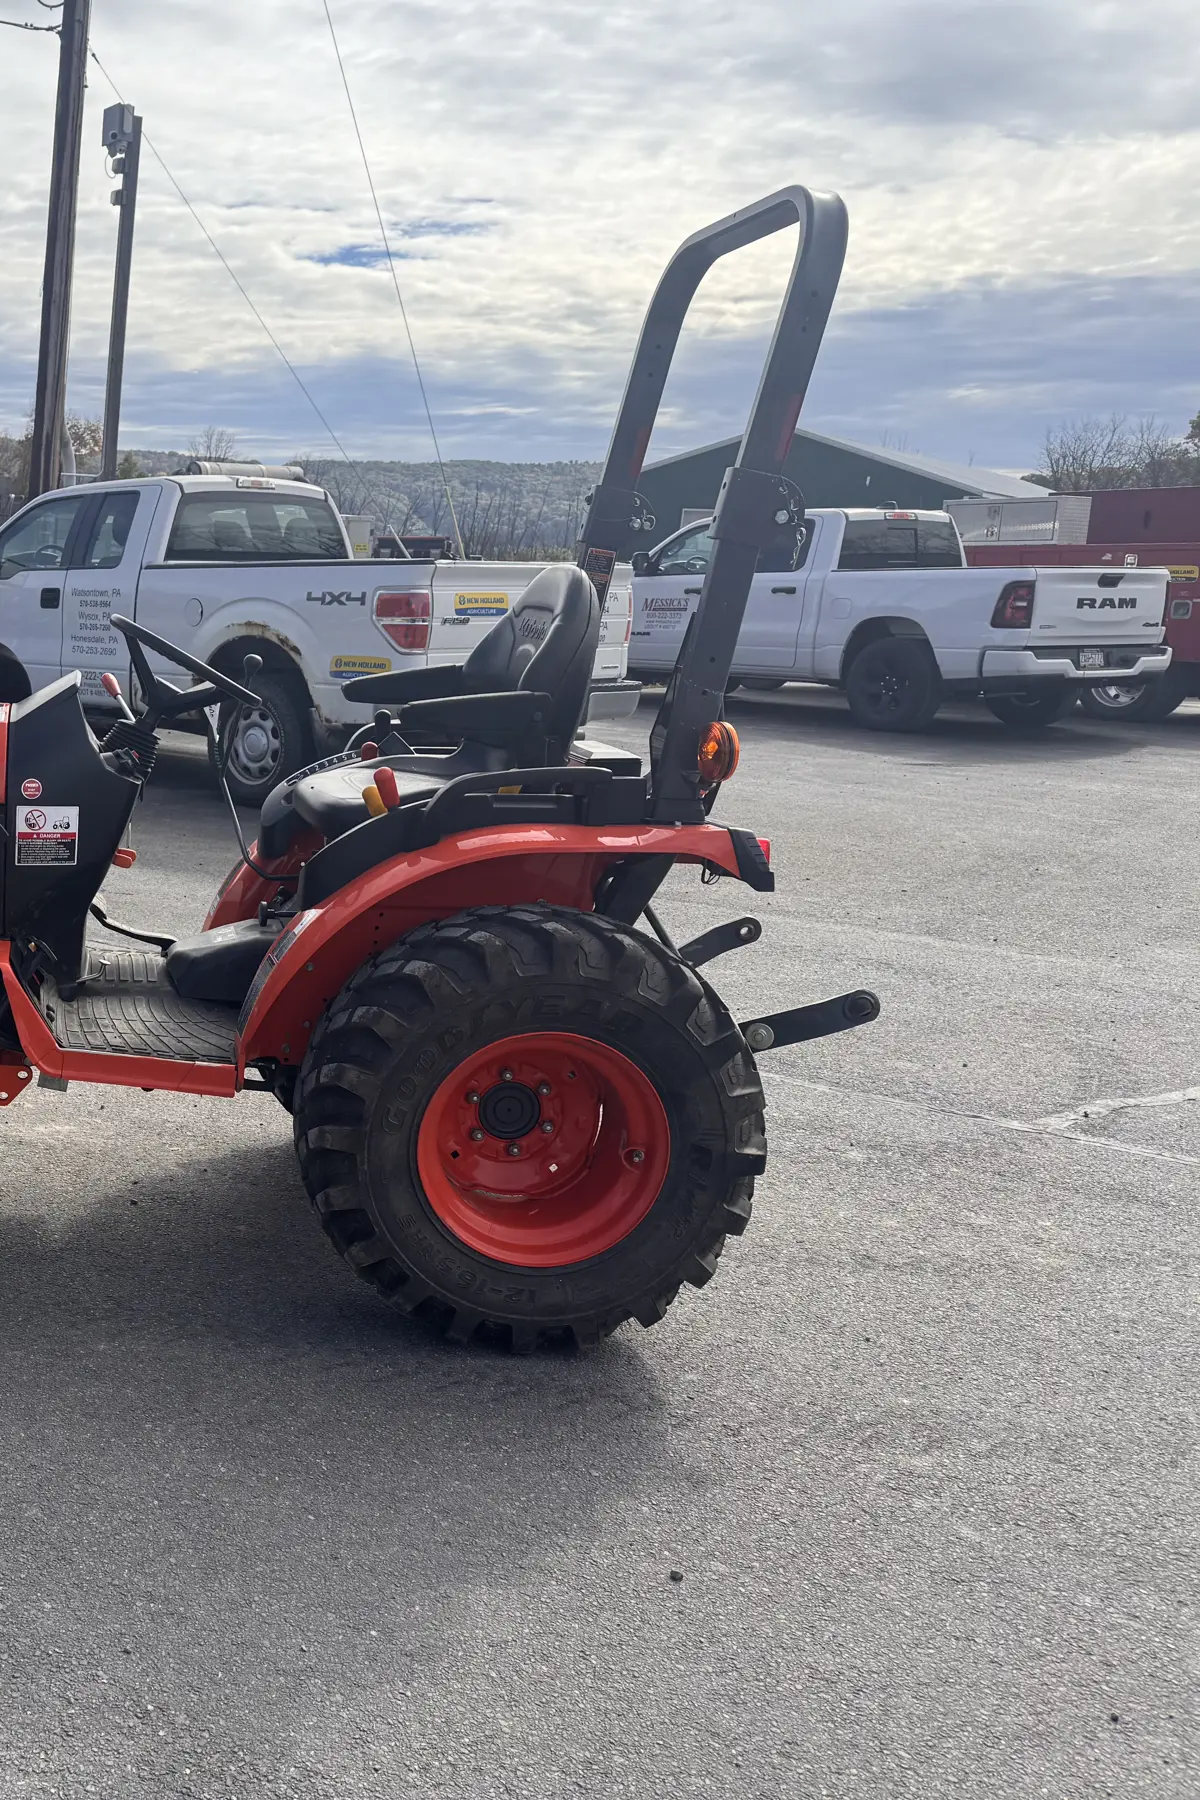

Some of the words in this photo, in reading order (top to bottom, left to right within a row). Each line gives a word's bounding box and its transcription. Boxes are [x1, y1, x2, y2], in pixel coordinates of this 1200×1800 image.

[1076, 597, 1137, 609] RAM
[71, 634, 107, 645] Honesdale,
[343, 660, 357, 668] NEW
[358, 661, 387, 670] HOLLAND
